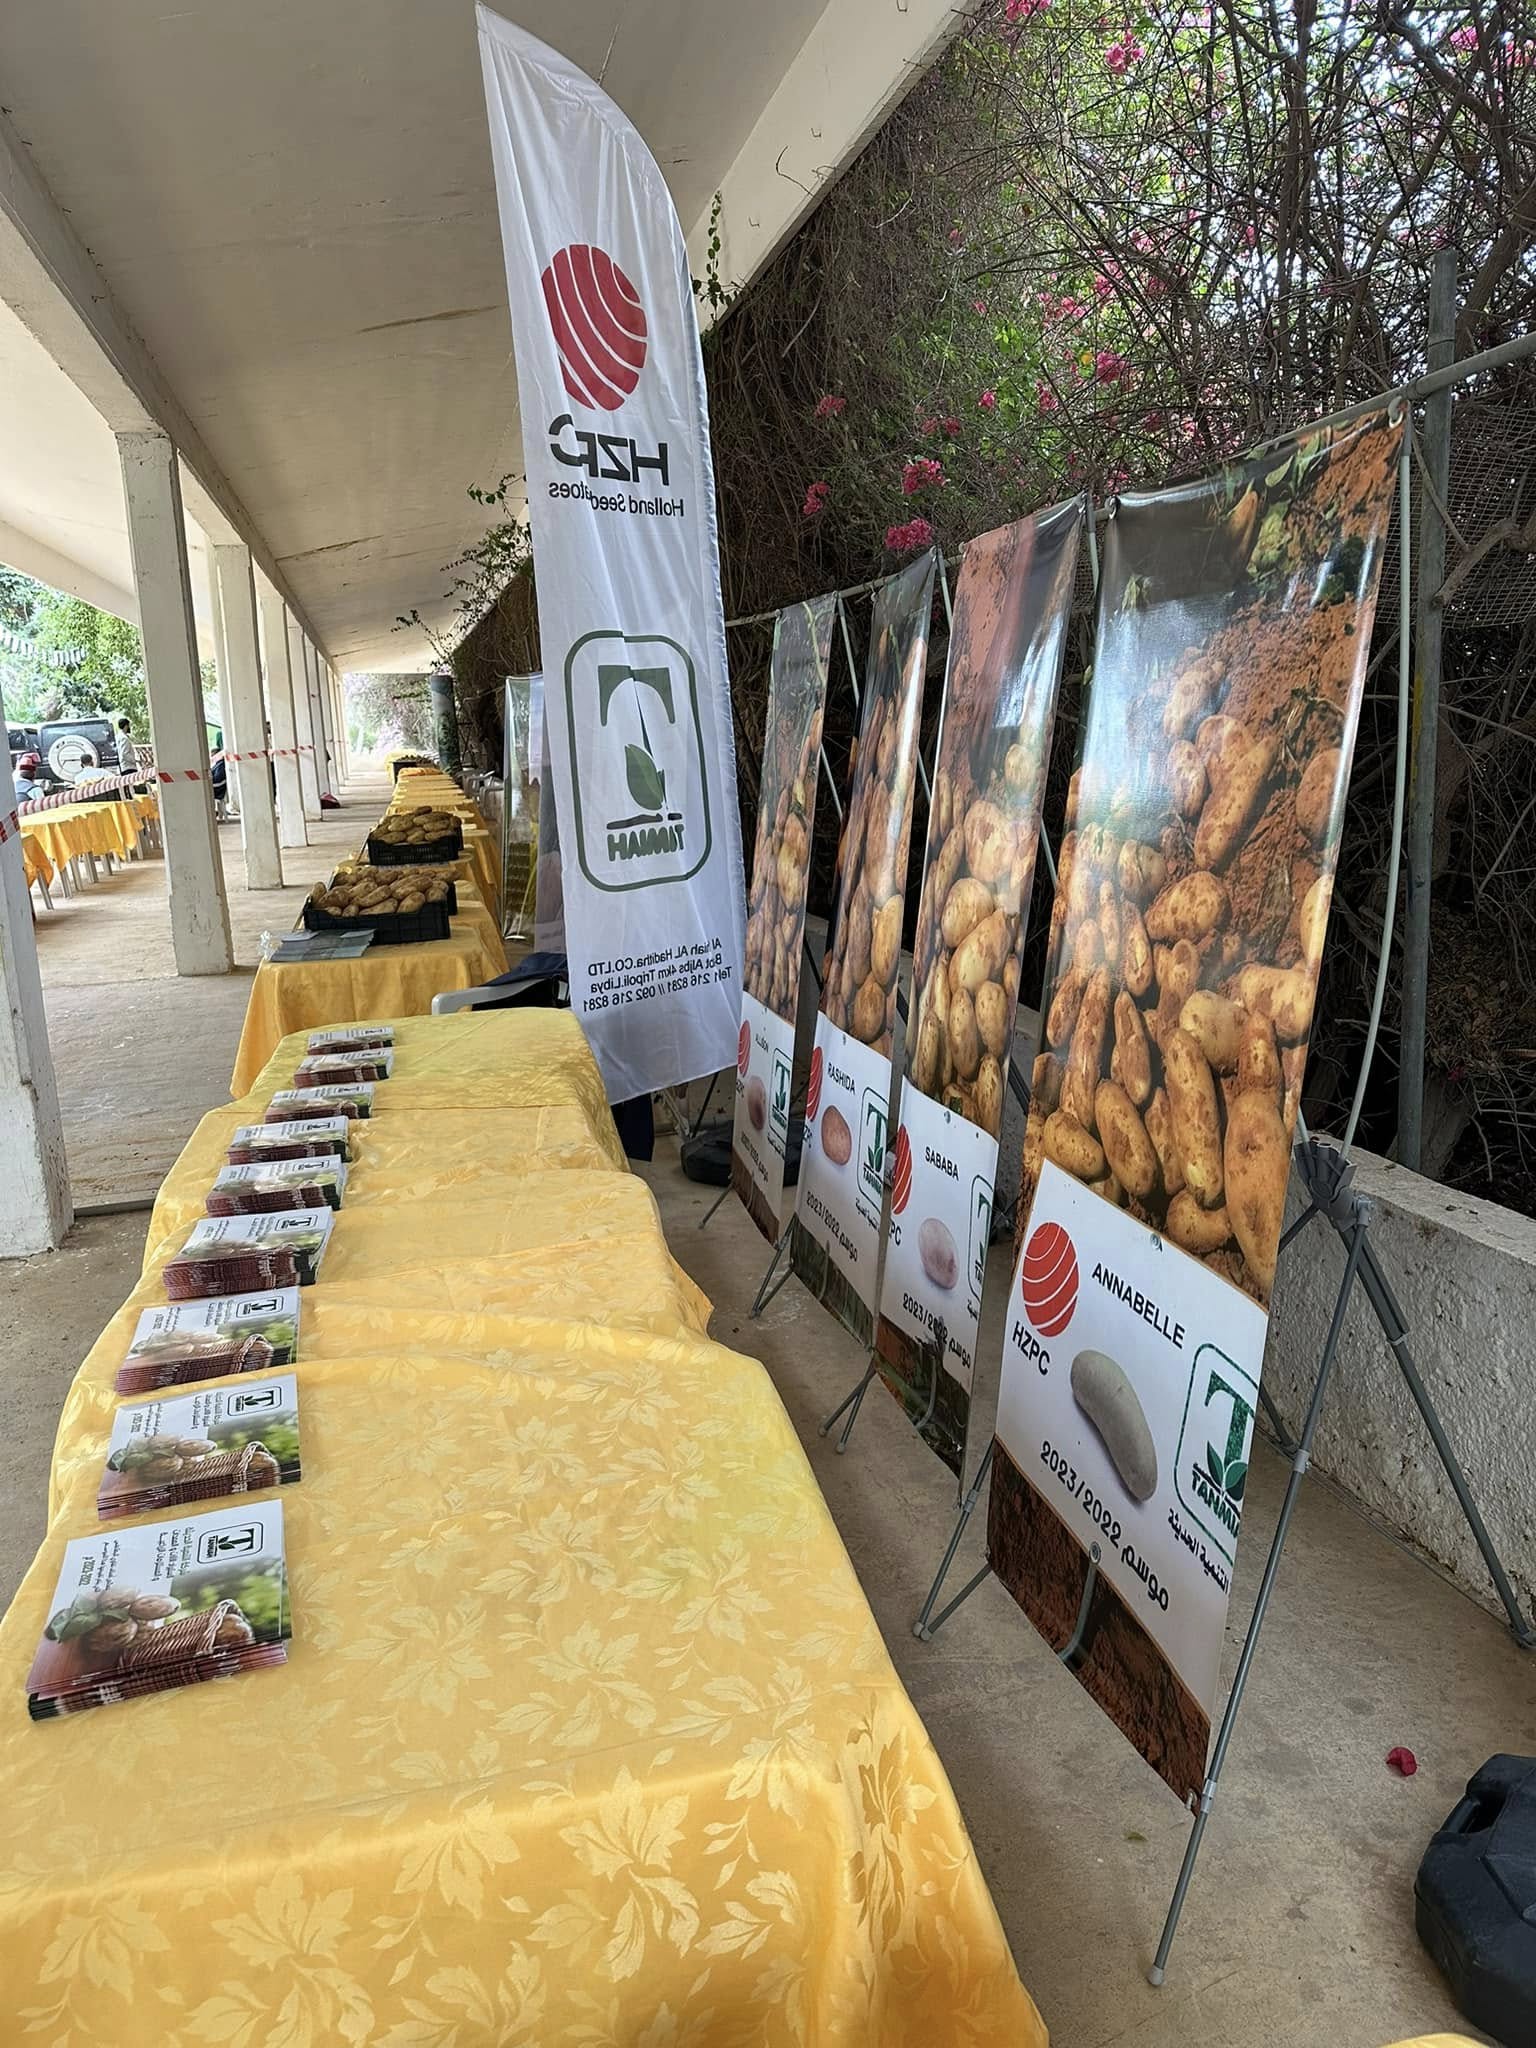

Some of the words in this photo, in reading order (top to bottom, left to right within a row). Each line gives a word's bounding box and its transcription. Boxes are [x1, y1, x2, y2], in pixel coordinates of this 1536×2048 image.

[925, 1146, 959, 1181] SABABA
[1091, 1262, 1186, 1350] ANNABELLE
[948, 1337, 971, 1369] موسم
[1012, 1320, 1050, 1376] HZPC
[1040, 1440, 1122, 1549] 2023/2022
[1167, 1508, 1200, 1557] الحديثة
[1120, 1545, 1169, 1611] موسم
[1199, 1545, 1229, 1595] التنمية
